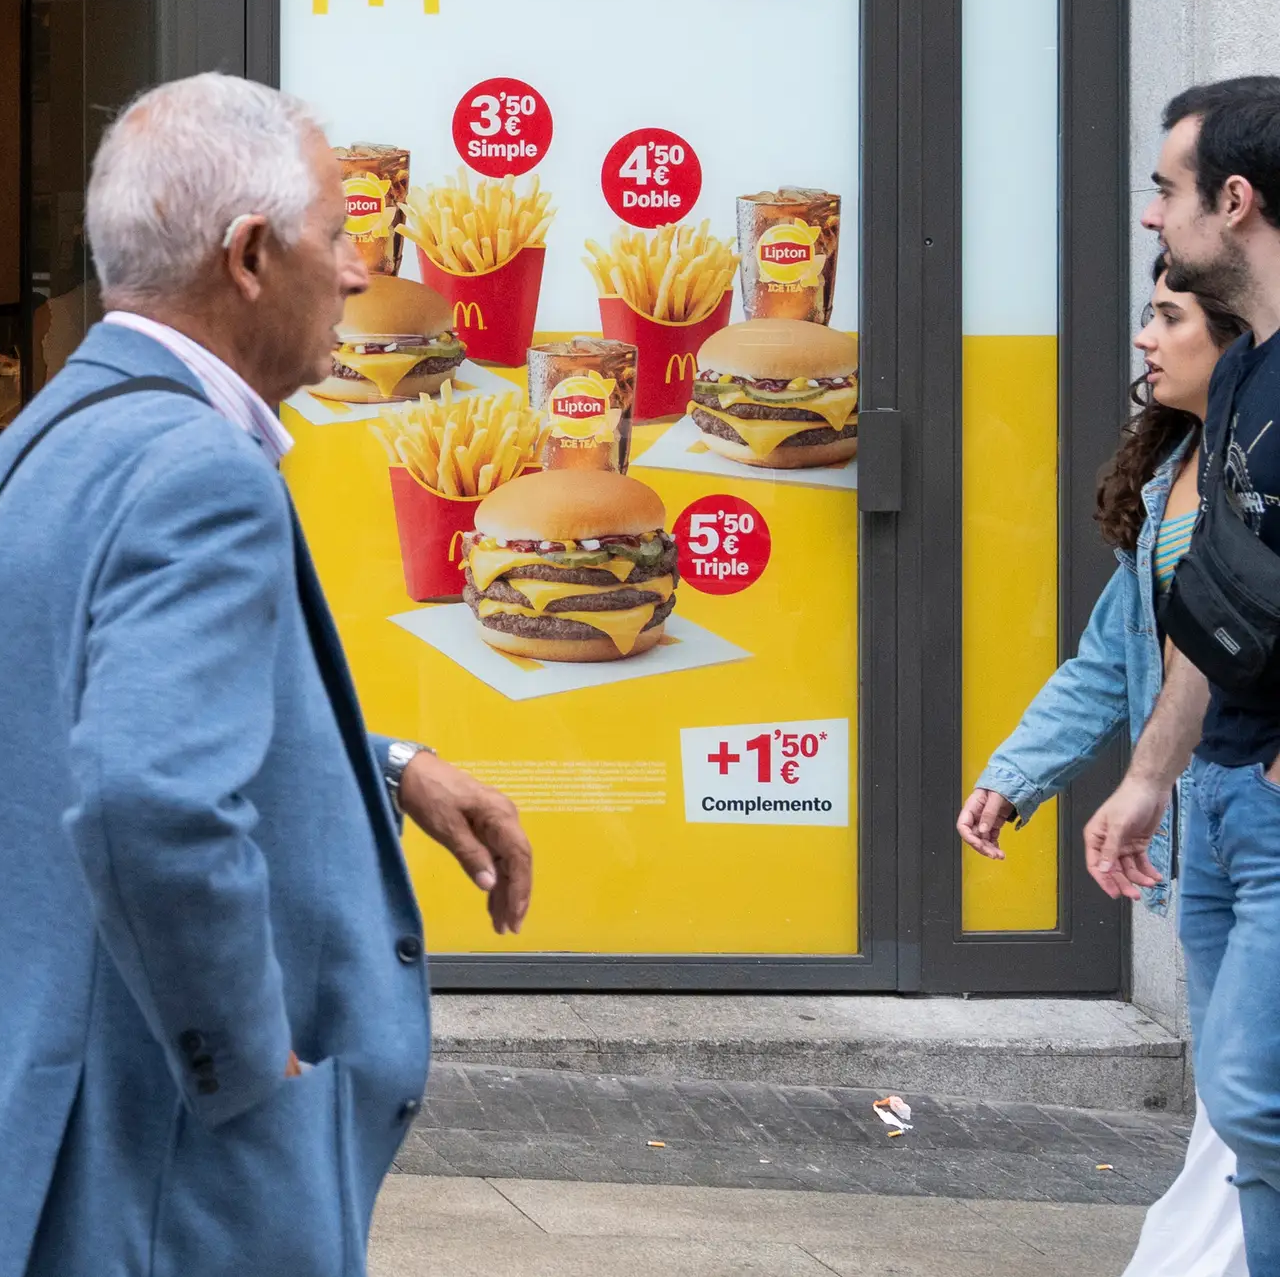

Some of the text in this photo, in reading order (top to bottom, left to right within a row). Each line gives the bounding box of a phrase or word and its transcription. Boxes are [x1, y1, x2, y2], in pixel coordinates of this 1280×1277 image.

[467, 139, 538, 161] Simple
[345, 199, 378, 213] ipton
[623, 190, 681, 208] Doble
[764, 247, 806, 261] Lipton
[768, 283, 784, 292] ICE
[557, 400, 601, 415] Lipton
[691, 558, 749, 580] Triple
[701, 796, 833, 816] Complemento
